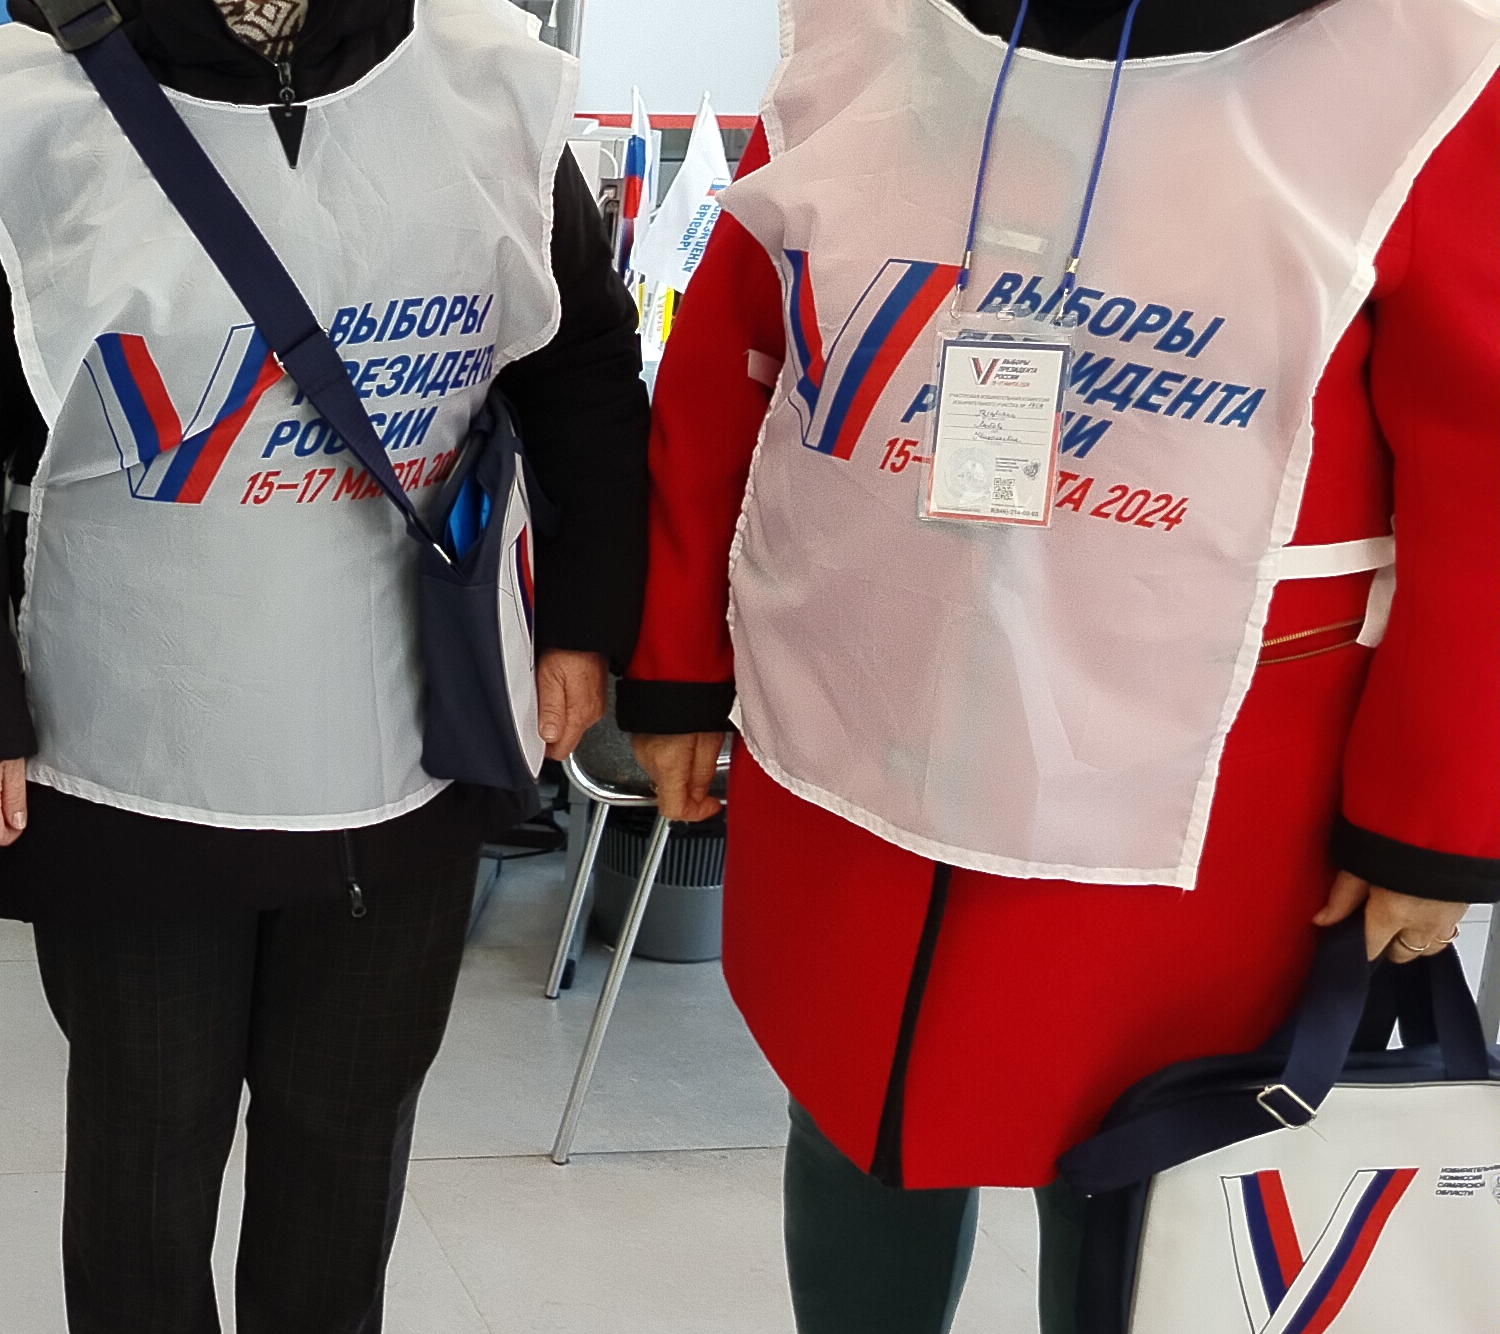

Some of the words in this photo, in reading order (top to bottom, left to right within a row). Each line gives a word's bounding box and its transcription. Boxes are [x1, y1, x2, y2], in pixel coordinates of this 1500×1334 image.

[328, 294, 494, 349] ВЫБОРЫ
[976, 271, 1225, 359] ВЫБОРЫ
[1090, 484, 1190, 532] 2024
